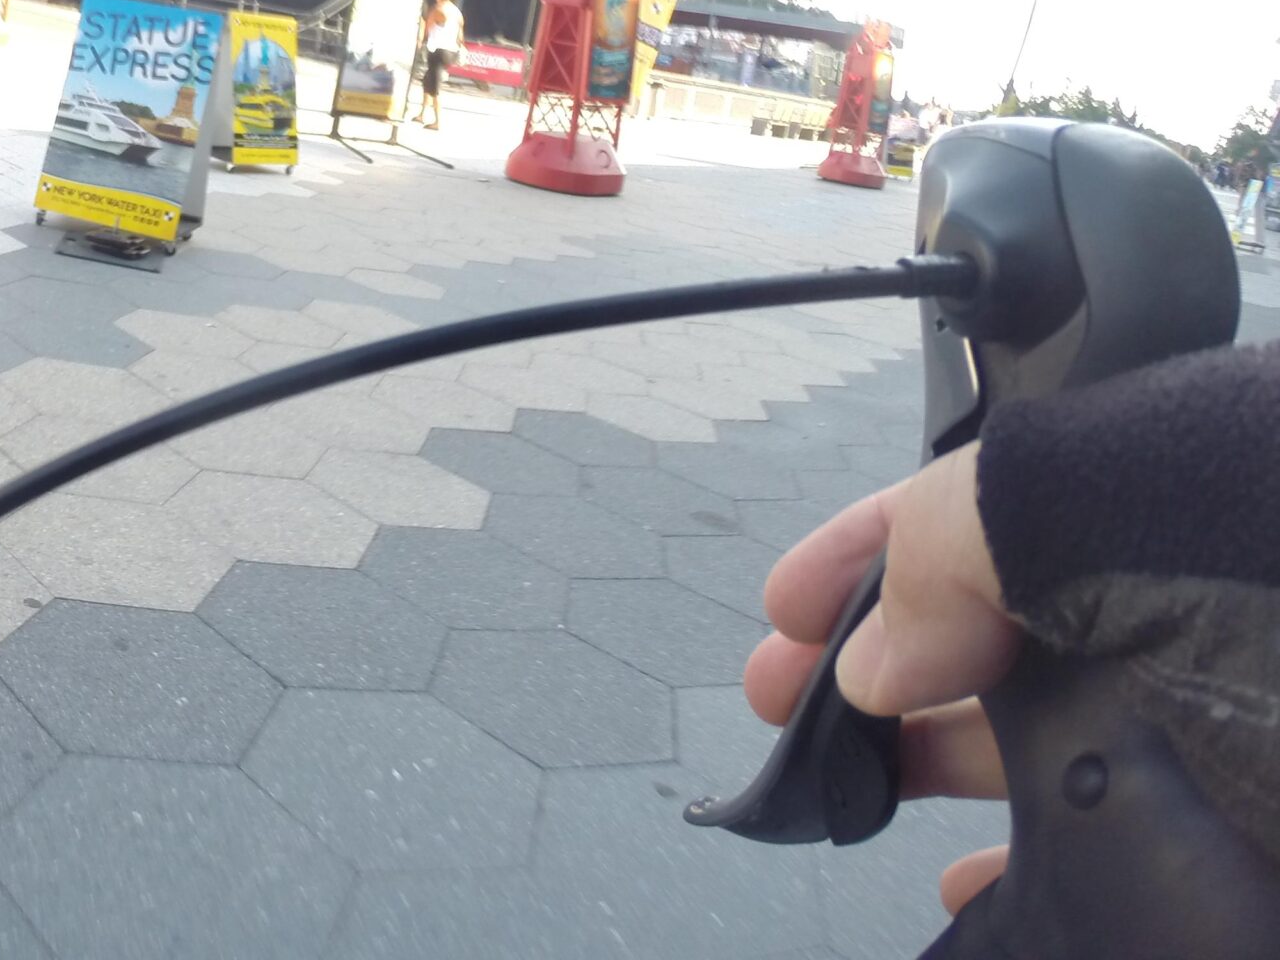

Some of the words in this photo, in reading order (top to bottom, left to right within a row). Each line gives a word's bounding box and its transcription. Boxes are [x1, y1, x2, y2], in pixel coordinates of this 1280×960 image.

[83, 11, 212, 51] STATUE
[69, 43, 215, 86] EXPRESS
[53, 185, 77, 197] NEW
[78, 189, 104, 205] YORK
[106, 197, 139, 214] WATER
[140, 204, 163, 219] TAXI
